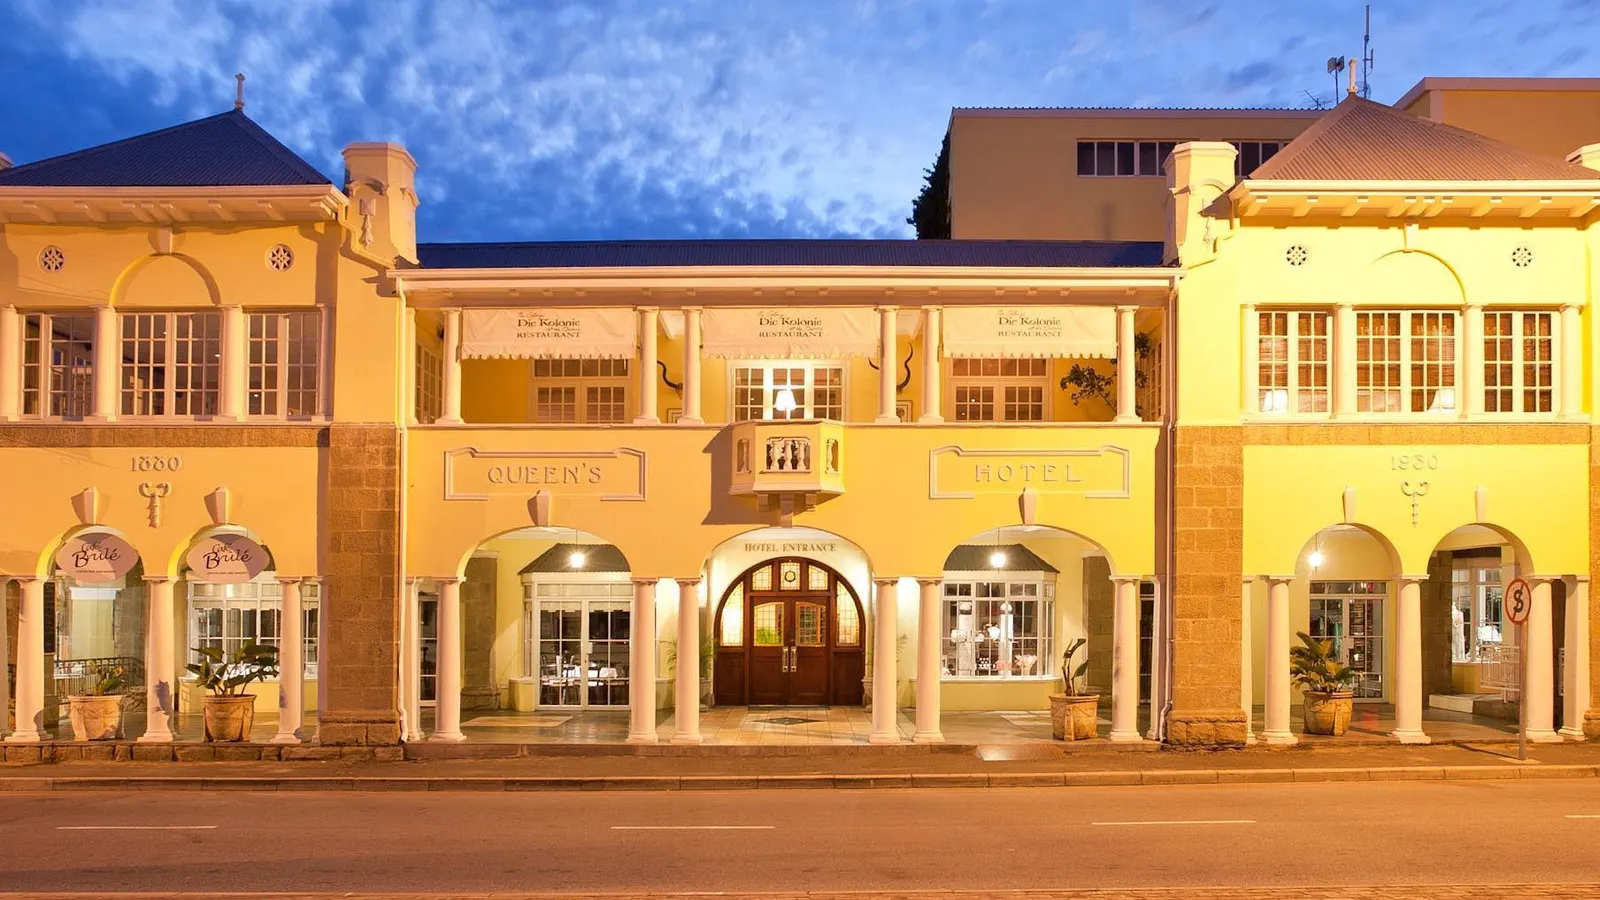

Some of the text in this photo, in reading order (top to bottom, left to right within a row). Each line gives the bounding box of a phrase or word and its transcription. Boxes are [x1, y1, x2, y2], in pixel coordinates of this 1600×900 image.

[539, 317, 580, 327] Kolonie
[131, 455, 182, 472] 1880
[488, 462, 602, 485] QUEEN'S
[975, 464, 1082, 483] HOTEL
[744, 542, 837, 552] HOTEL ENTRANCE
